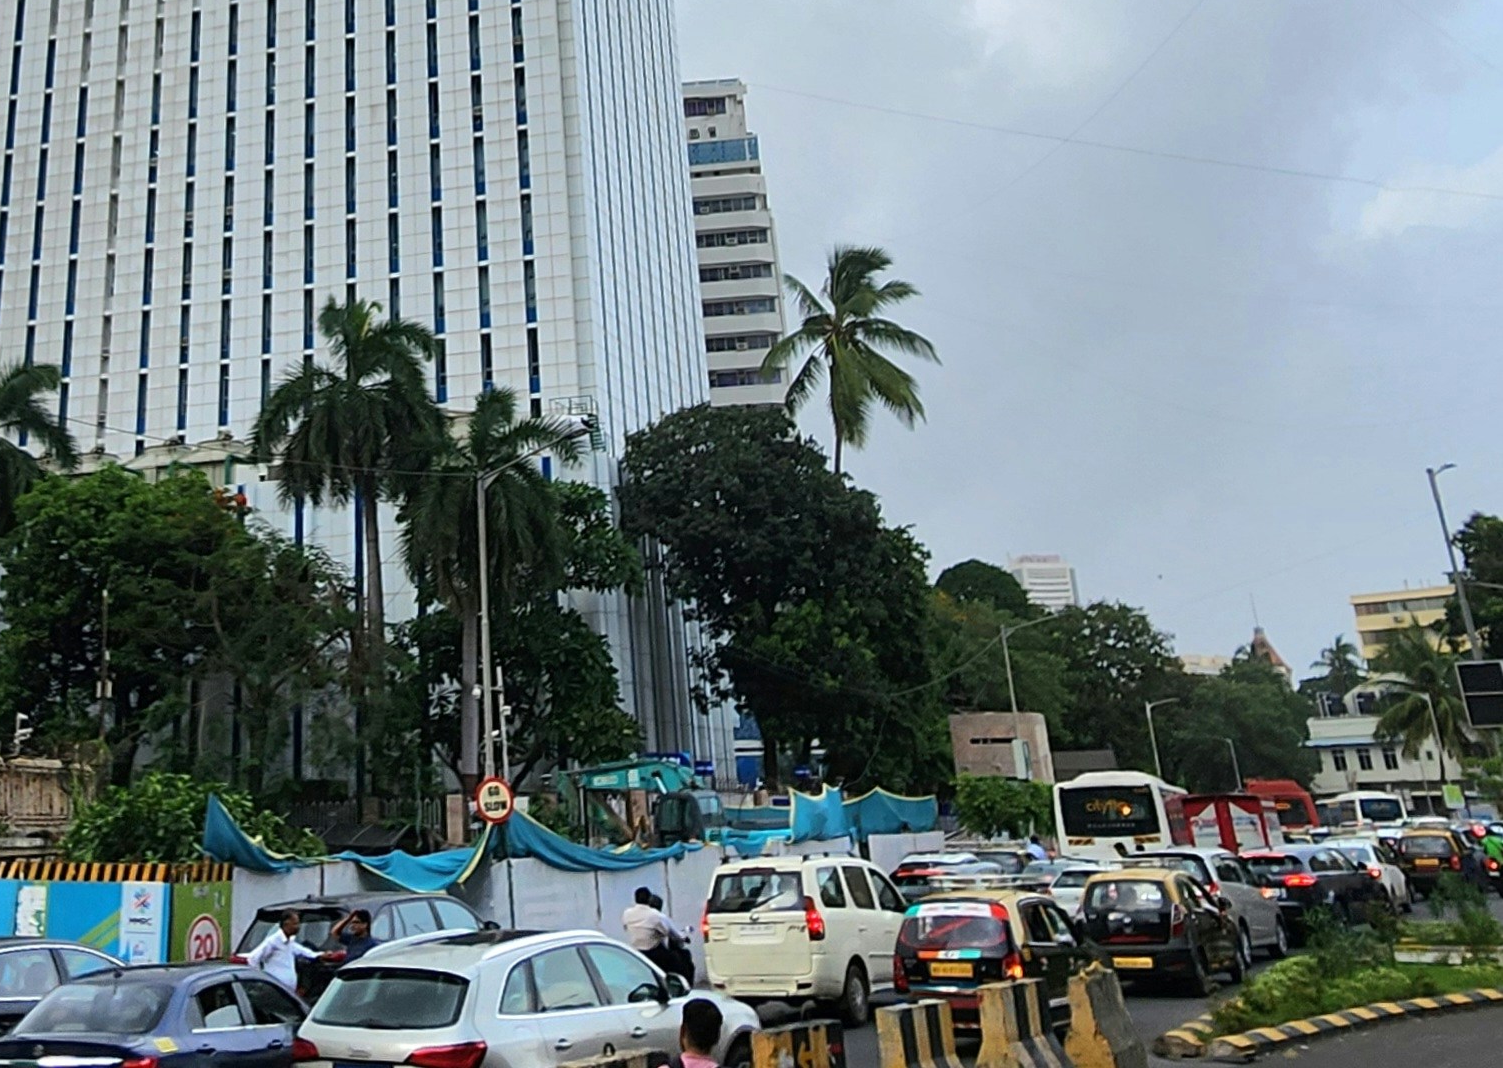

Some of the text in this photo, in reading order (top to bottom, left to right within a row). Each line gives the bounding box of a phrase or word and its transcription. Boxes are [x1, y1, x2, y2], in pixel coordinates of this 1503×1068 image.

[488, 785, 500, 796] GO
[484, 800, 507, 812] SLOW
[194, 933, 214, 959] 20
